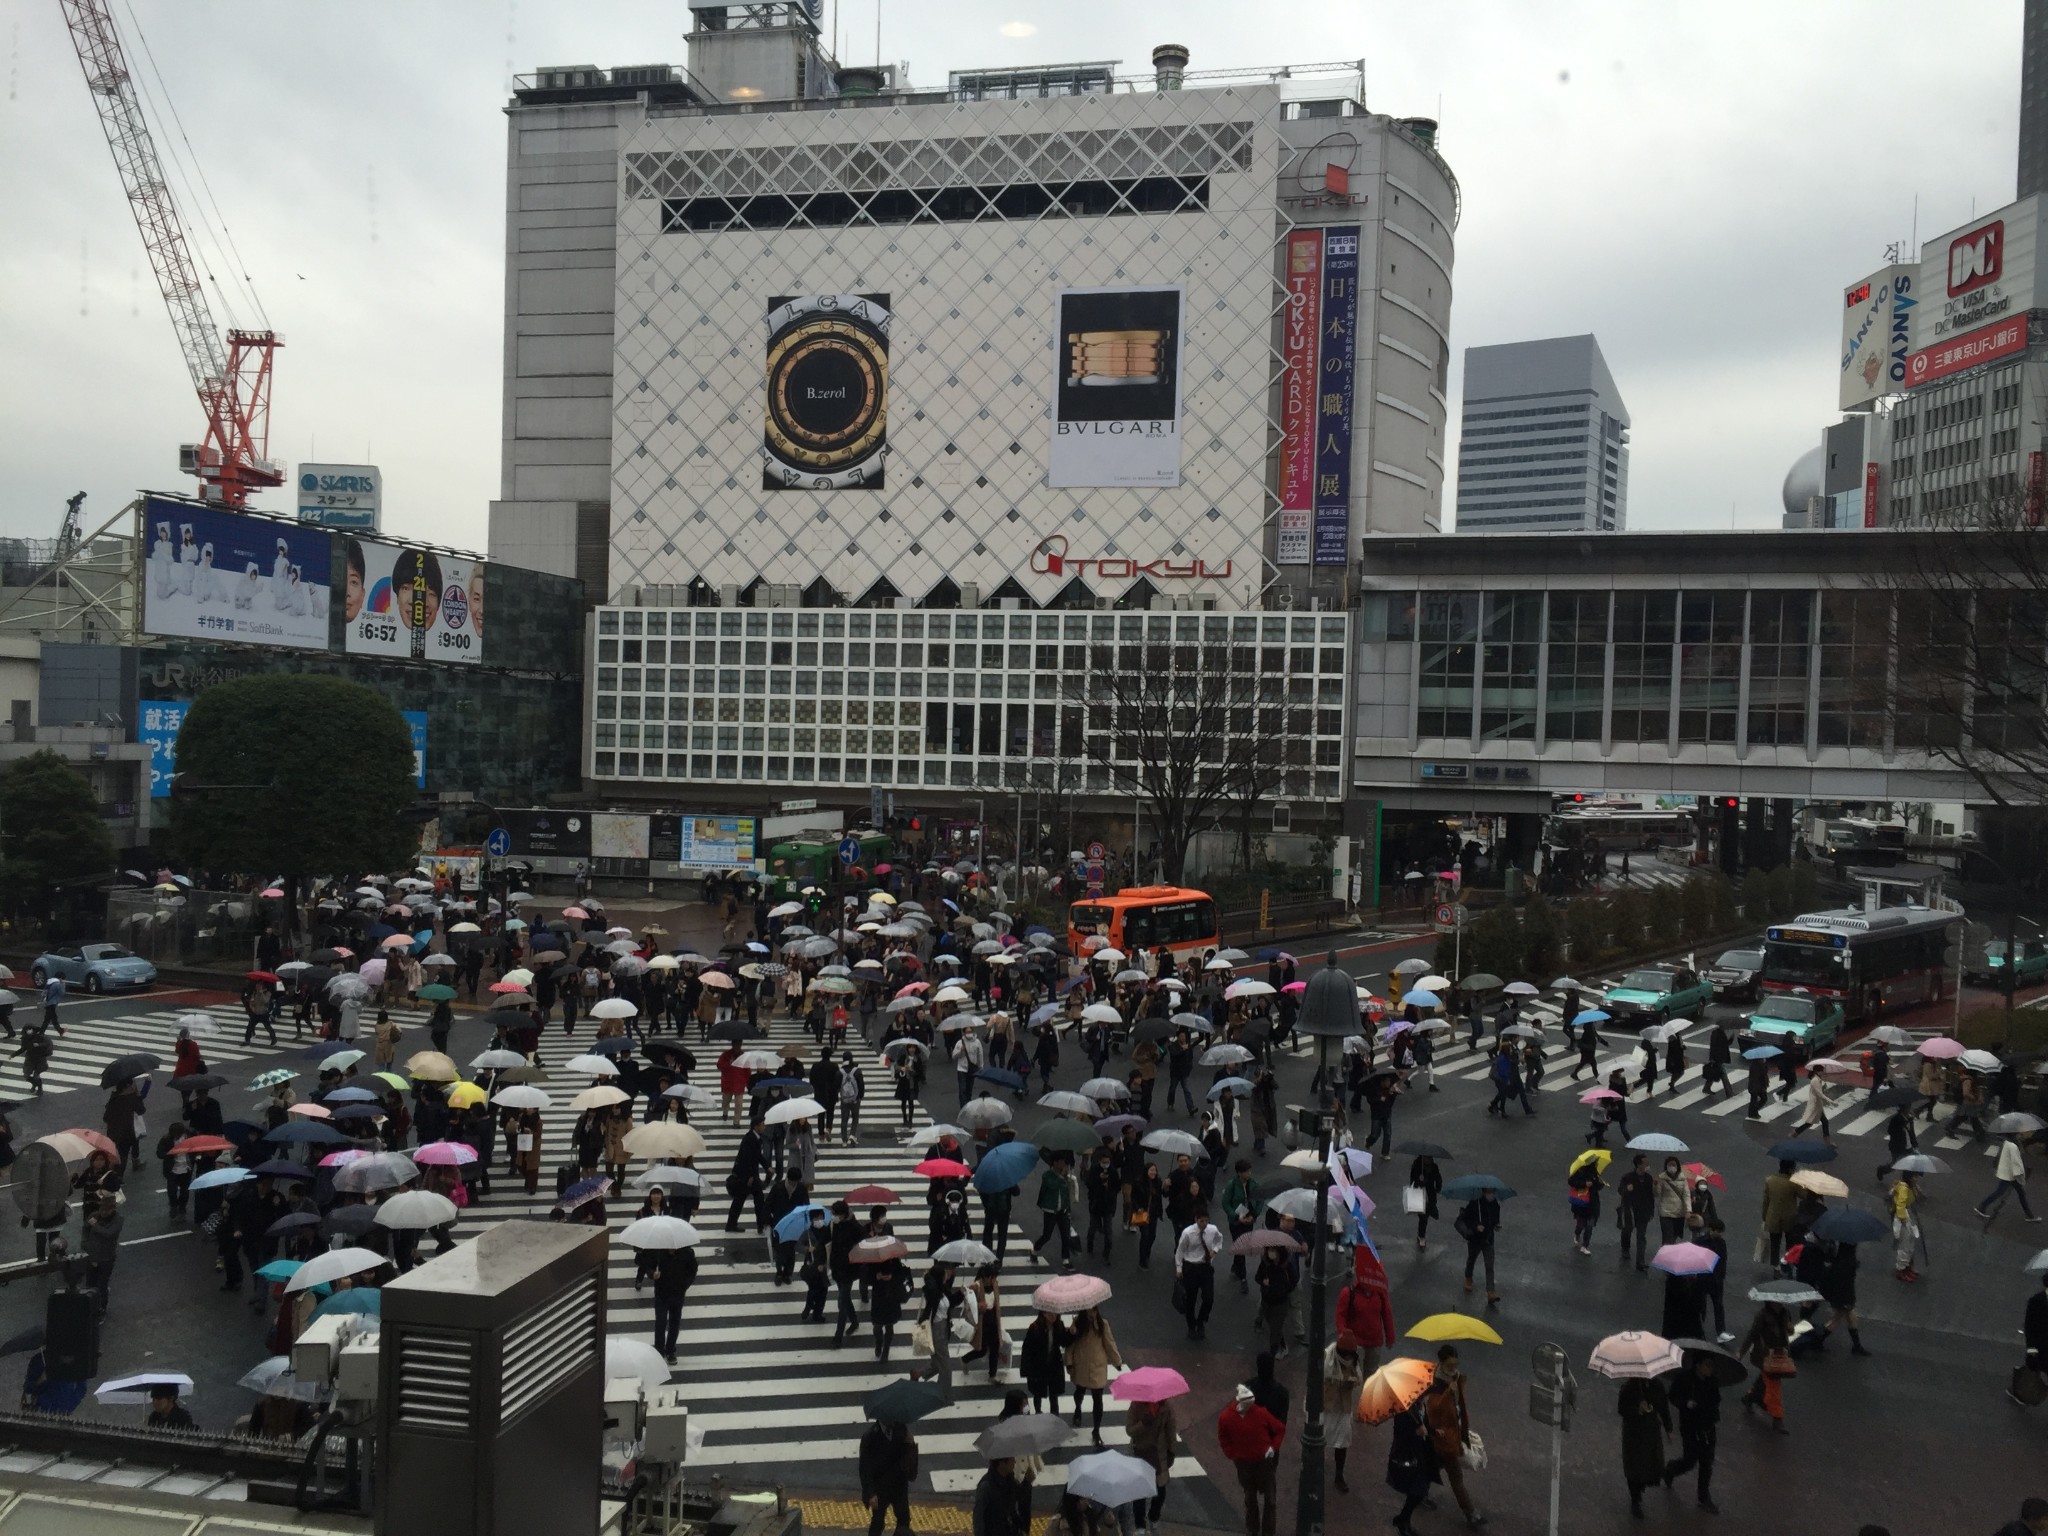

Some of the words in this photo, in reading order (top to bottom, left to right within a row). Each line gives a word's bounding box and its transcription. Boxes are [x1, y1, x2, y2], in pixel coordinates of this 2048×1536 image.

[1283, 194, 1368, 209] TOKYU
[1289, 277, 1307, 350] TOKYU
[1944, 301, 1960, 316] DC
[1962, 289, 1986, 309] VISA
[1934, 321, 1950, 336] DC
[1951, 296, 2010, 329] MasterCard
[1842, 284, 1889, 372] SANKYO
[1890, 275, 1919, 382] SANKYO
[1934, 327, 2018, 370] 三菱東京UFJ銀行
[1288, 354, 1303, 414] CARD
[1319, 278, 1346, 497] 日本の職人展
[1057, 420, 1176, 435] BVLGARI
[320, 475, 374, 493] STARTS
[317, 495, 357, 506] スターツ
[1064, 560, 1232, 578] TOKYU
[444, 601, 467, 610] LONDON
[249, 621, 284, 636] SoftBank
[364, 624, 397, 643] 6:57
[443, 632, 471, 649] 9:00
[150, 662, 185, 689] JR
[145, 708, 189, 731] 就活
